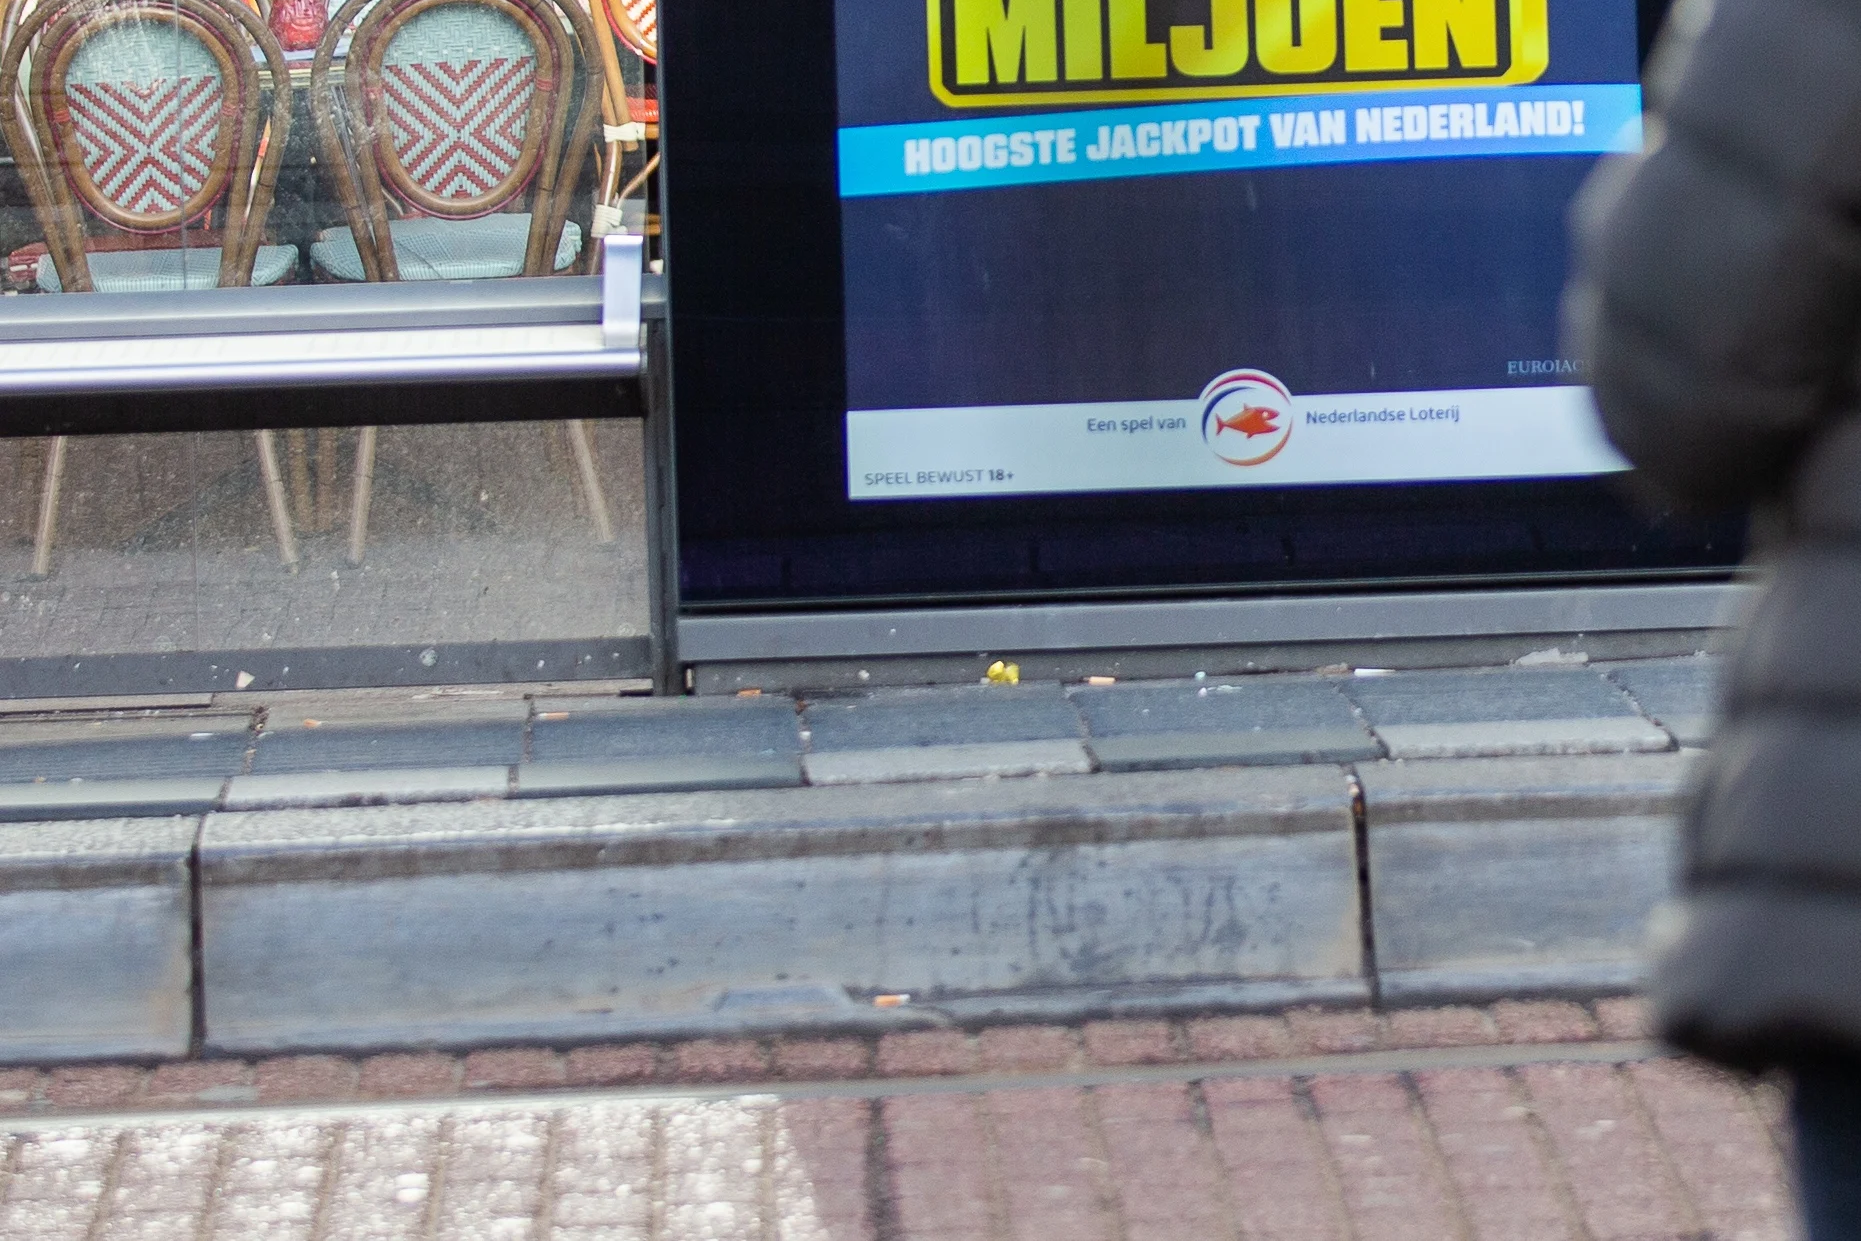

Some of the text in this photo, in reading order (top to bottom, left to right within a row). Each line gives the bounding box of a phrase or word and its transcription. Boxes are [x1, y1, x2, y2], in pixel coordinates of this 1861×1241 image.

[903, 99, 1585, 175] HOOGSTE JACKPOT VAN NEDERLAND!
[1086, 415, 1187, 435] Een spel van
[1305, 405, 1460, 425] Nederlandse Loterij
[864, 468, 1015, 486] SPEEL BEWUST 18+
